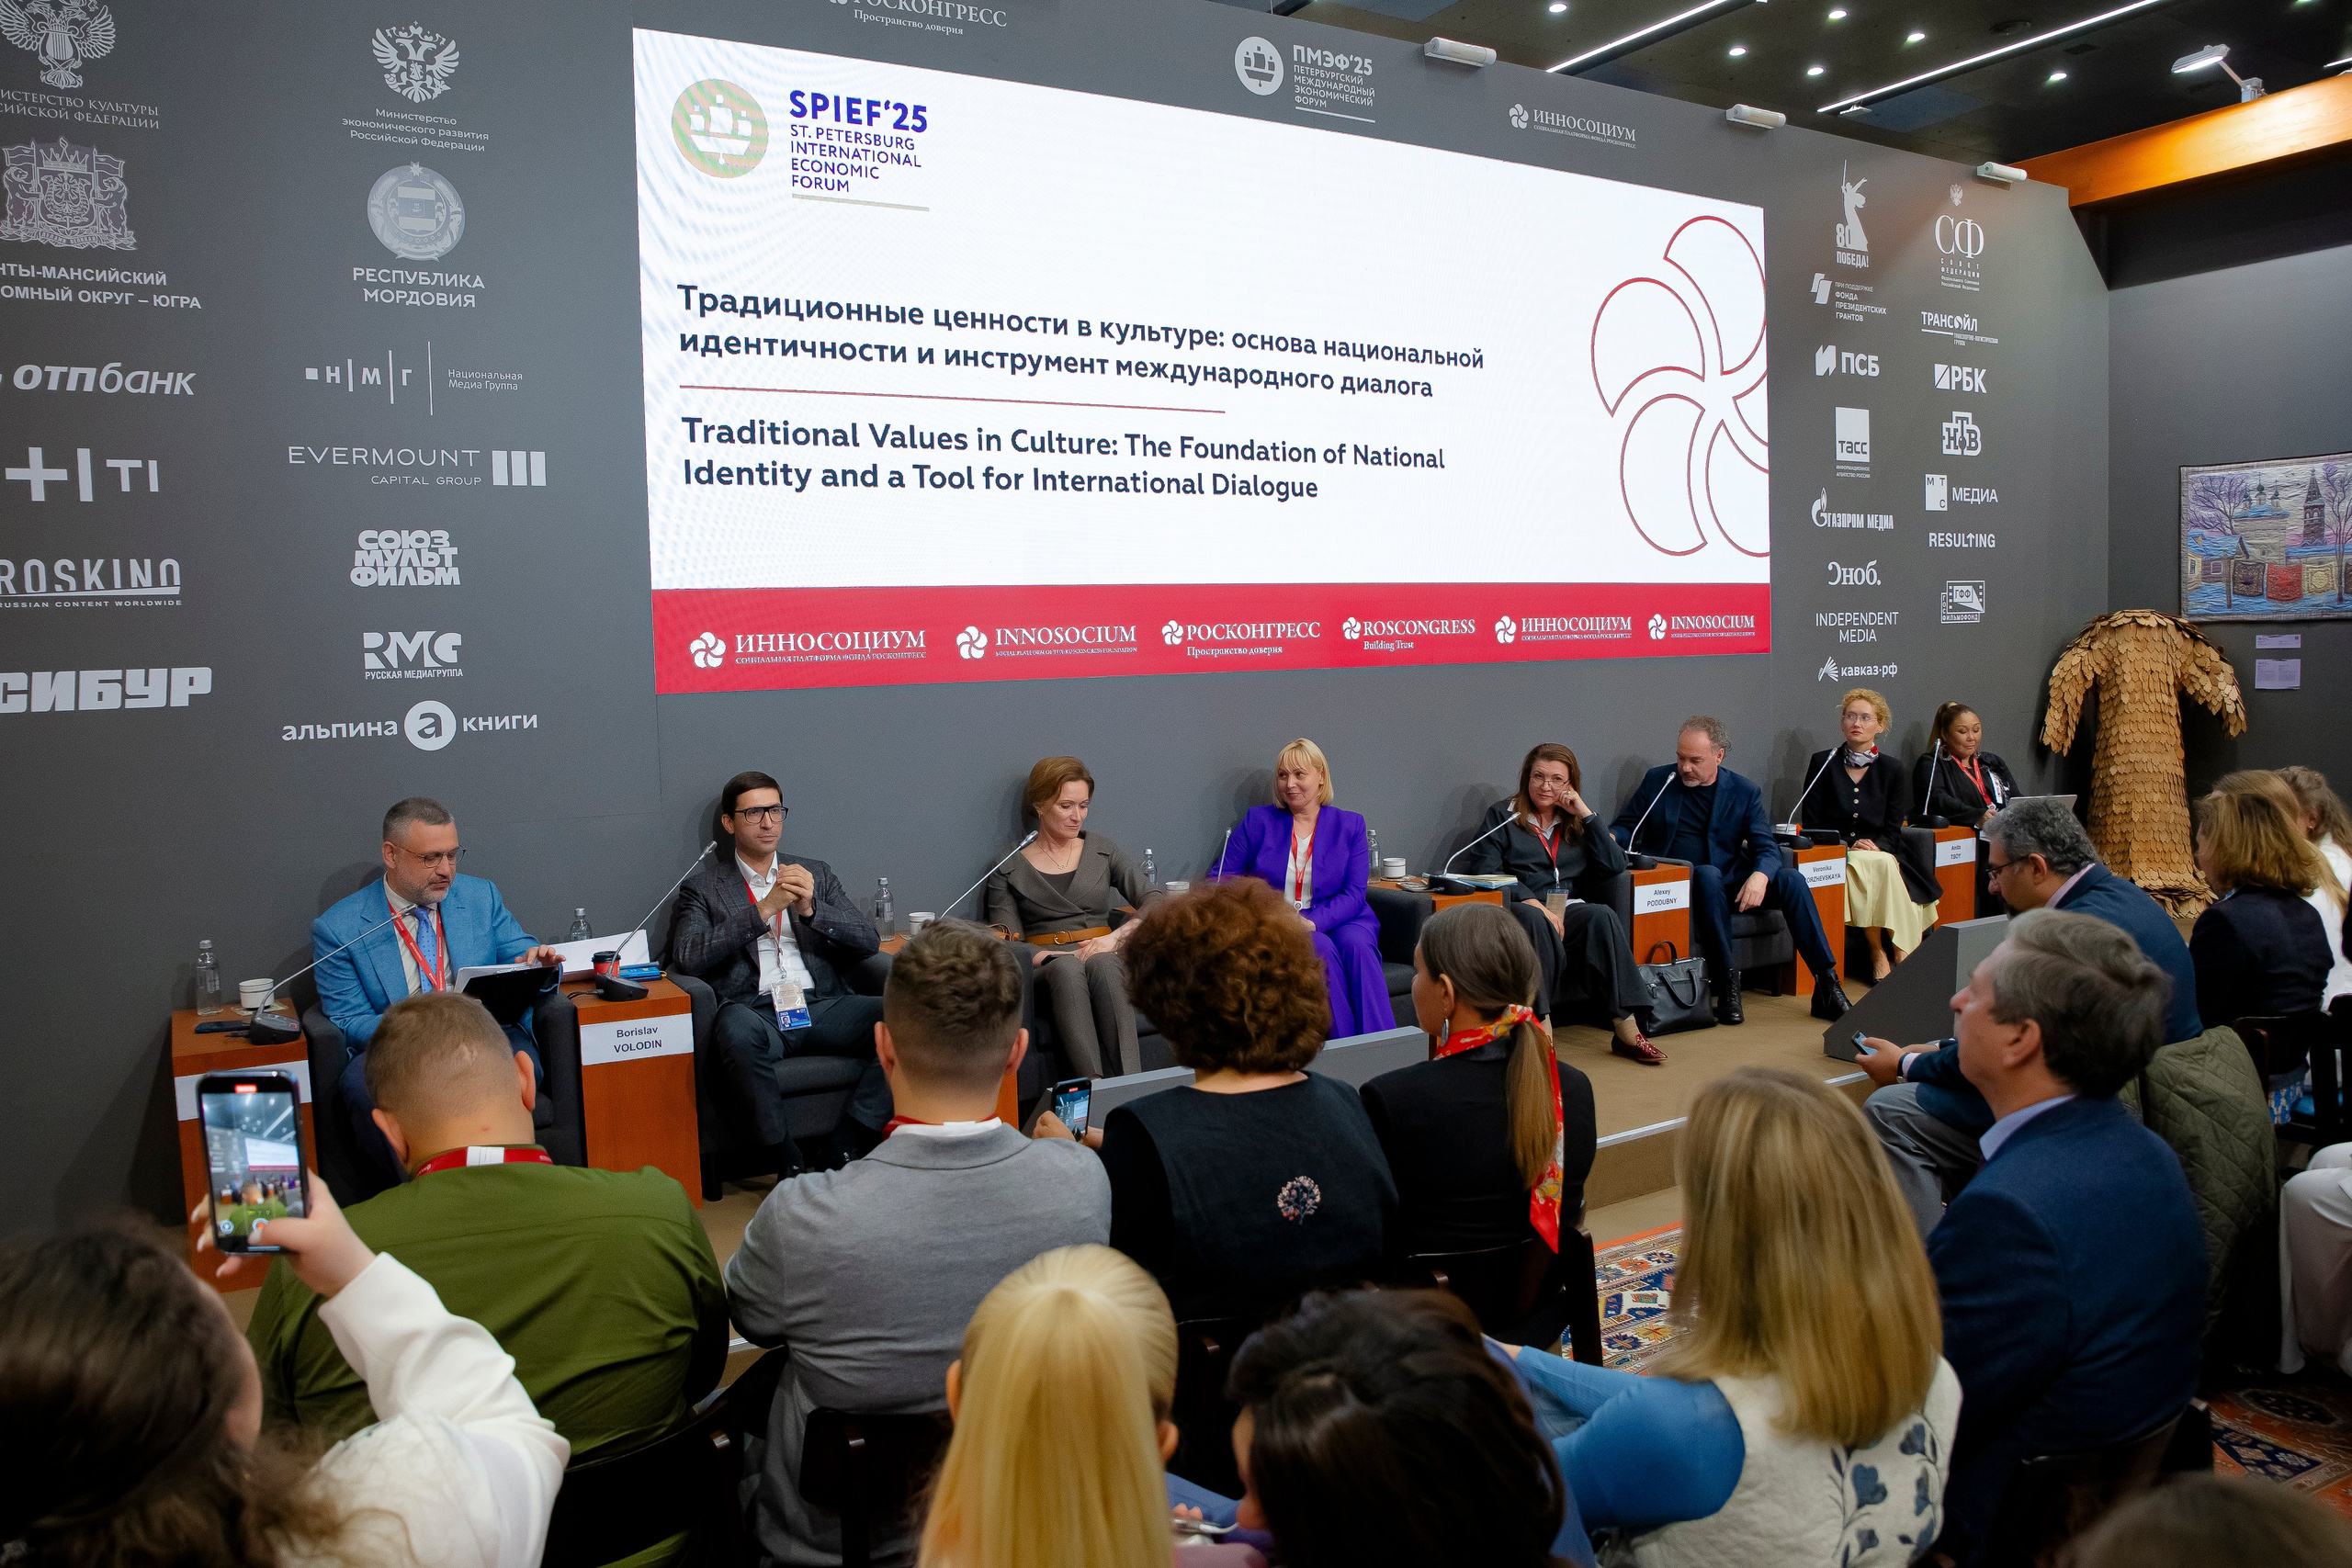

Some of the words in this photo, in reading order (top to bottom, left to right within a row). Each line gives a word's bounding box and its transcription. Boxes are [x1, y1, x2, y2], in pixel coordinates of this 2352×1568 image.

[854, 0, 1007, 28] СКОНГРЕСС
[854, 8, 923, 28] Пространство
[925, 23, 964, 36] доверия
[1294, 65, 1363, 85] ПЕТЕРБУРГСКИЙ
[1294, 75, 1375, 97] МЕЖДУНАРОДНЫЙ
[1294, 85, 1374, 107] ЭКОНОМИЧЕСКИЙ
[89, 99, 158, 116] КУЛЬТУРЫ
[1295, 96, 1327, 107] ФОРУМ
[74, 111, 159, 129] ФЕДЕРАЦИИ
[375, 107, 457, 126] Министерство
[1532, 108, 1636, 141] ИННОСОЦИУМ
[342, 118, 435, 136] экономического
[438, 127, 489, 141] развития
[790, 124, 812, 139] ST.
[816, 127, 915, 150] PETERSBURG
[350, 130, 418, 146] Российской
[421, 136, 485, 152] Федерации
[791, 141, 922, 168] INTERNATIONAL
[791, 157, 879, 179] ECONOMIC
[791, 175, 850, 193] FORUM
[1934, 214, 1984, 259] СФ
[1836, 251, 1869, 268] ПОБЕДА!
[353, 266, 486, 289] РЕСПУБЛИКА
[0, 285, 73, 301] ОМНЫЙ
[78, 289, 134, 305] ОКРУГ
[153, 294, 202, 310] ЮГРА
[363, 288, 476, 308] МОРДОВИЯ
[1835, 290, 1859, 301] ФОНДА
[1835, 301, 1887, 315] ПРЕЗИДЕНТСКИХ
[1836, 311, 1864, 321] ГРАНТОВ
[677, 284, 924, 325] Традиционные
[933, 309, 1068, 336] ценности
[1078, 320, 1091, 336] в
[1100, 321, 1225, 350] культуре:
[1232, 332, 1317, 355] основа
[1324, 340, 1484, 368] национальной
[447, 368, 523, 381] Национальная
[680, 333, 907, 363] идентичности
[918, 346, 934, 365] и
[944, 348, 1108, 377] инструмент
[1116, 358, 1334, 389] международного
[1340, 375, 1433, 397] диалога
[1841, 351, 1880, 378] ПСБ
[448, 378, 482, 390] Медиа
[485, 380, 518, 391] Группа
[1951, 365, 1986, 393] РБК
[682, 416, 860, 447] Traditional
[868, 423, 968, 450] Values
[977, 427, 1001, 452] in
[1011, 428, 1118, 456] Culture:
[1125, 433, 1171, 457] The
[1180, 435, 1317, 463] Foundation
[1323, 443, 1347, 465] of
[1353, 444, 1445, 468] National
[288, 446, 481, 467] EVERMOUNT
[371, 475, 429, 485] CAPITAL
[436, 476, 481, 486] GROUP
[684, 458, 812, 493] Identity
[821, 463, 879, 488] and
[888, 469, 906, 488] a
[912, 464, 975, 490] Tool
[982, 465, 1024, 491] for
[1033, 467, 1204, 494] International
[1212, 472, 1318, 502] Dialogue
[1951, 487, 1998, 505] МЕДИА
[1826, 513, 1864, 528] ГАЗПРОМ
[1867, 513, 1894, 531] МЕДИА
[358, 529, 450, 550] СОЮЗ
[354, 547, 458, 568] МУЛЬТ
[349, 566, 461, 587] ФИЛЬМ
[1363, 618, 1476, 637] ROSCONGRESS
[1521, 616, 1632, 633] ИННОСОЦИУМ
[1670, 615, 1755, 630] INNOSOCIUM
[1815, 611, 1899, 626] INDEPENDENT
[735, 629, 926, 653] ИННОСОЦИУМ
[995, 625, 1136, 646] INNOSOCIUM
[1186, 621, 1320, 641] РОСКОНГРЕСС
[1838, 628, 1877, 643] MEDIA
[363, 630, 462, 669] RMG
[1187, 646, 1248, 658] Пространство
[1249, 646, 1283, 656] доверия
[1363, 640, 1395, 652] Building
[1395, 640, 1414, 649] Trust
[365, 670, 402, 680] РУССКАЯ
[404, 668, 463, 680] МЕДИАГРУППА
[0, 667, 212, 714] СИБУР
[281, 719, 398, 741] альпина
[462, 714, 538, 732] книги
[1646, 897, 1678, 908] PODDUBNY
[616, 1026, 659, 1038] Borislav
[614, 1039, 662, 1054] VOLODIN
